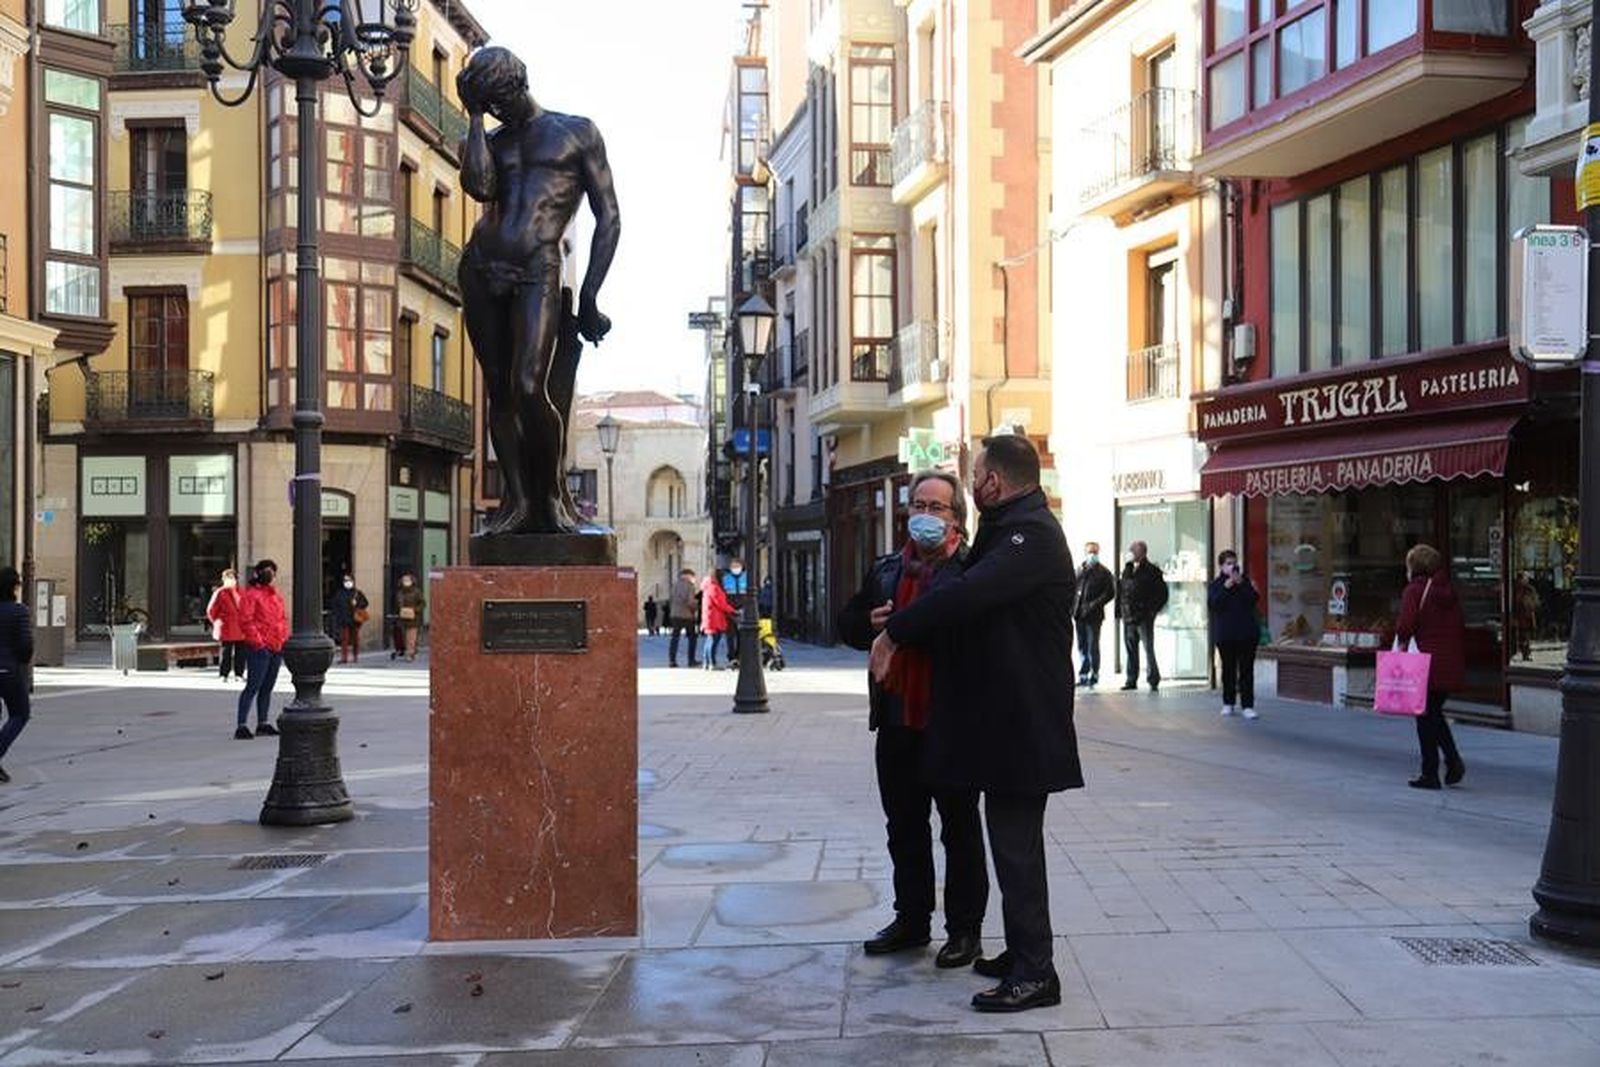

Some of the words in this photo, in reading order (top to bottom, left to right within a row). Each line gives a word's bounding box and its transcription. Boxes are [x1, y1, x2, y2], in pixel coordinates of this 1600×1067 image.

[1560, 234, 1569, 247] 3
[1204, 408, 1267, 429] PANADERIA
[1279, 375, 1408, 426] TRIGAL
[1421, 366, 1519, 397] PASTELERIA
[1246, 466, 1322, 491] PASTELERIA
[1337, 453, 1433, 482] PANADERIA
